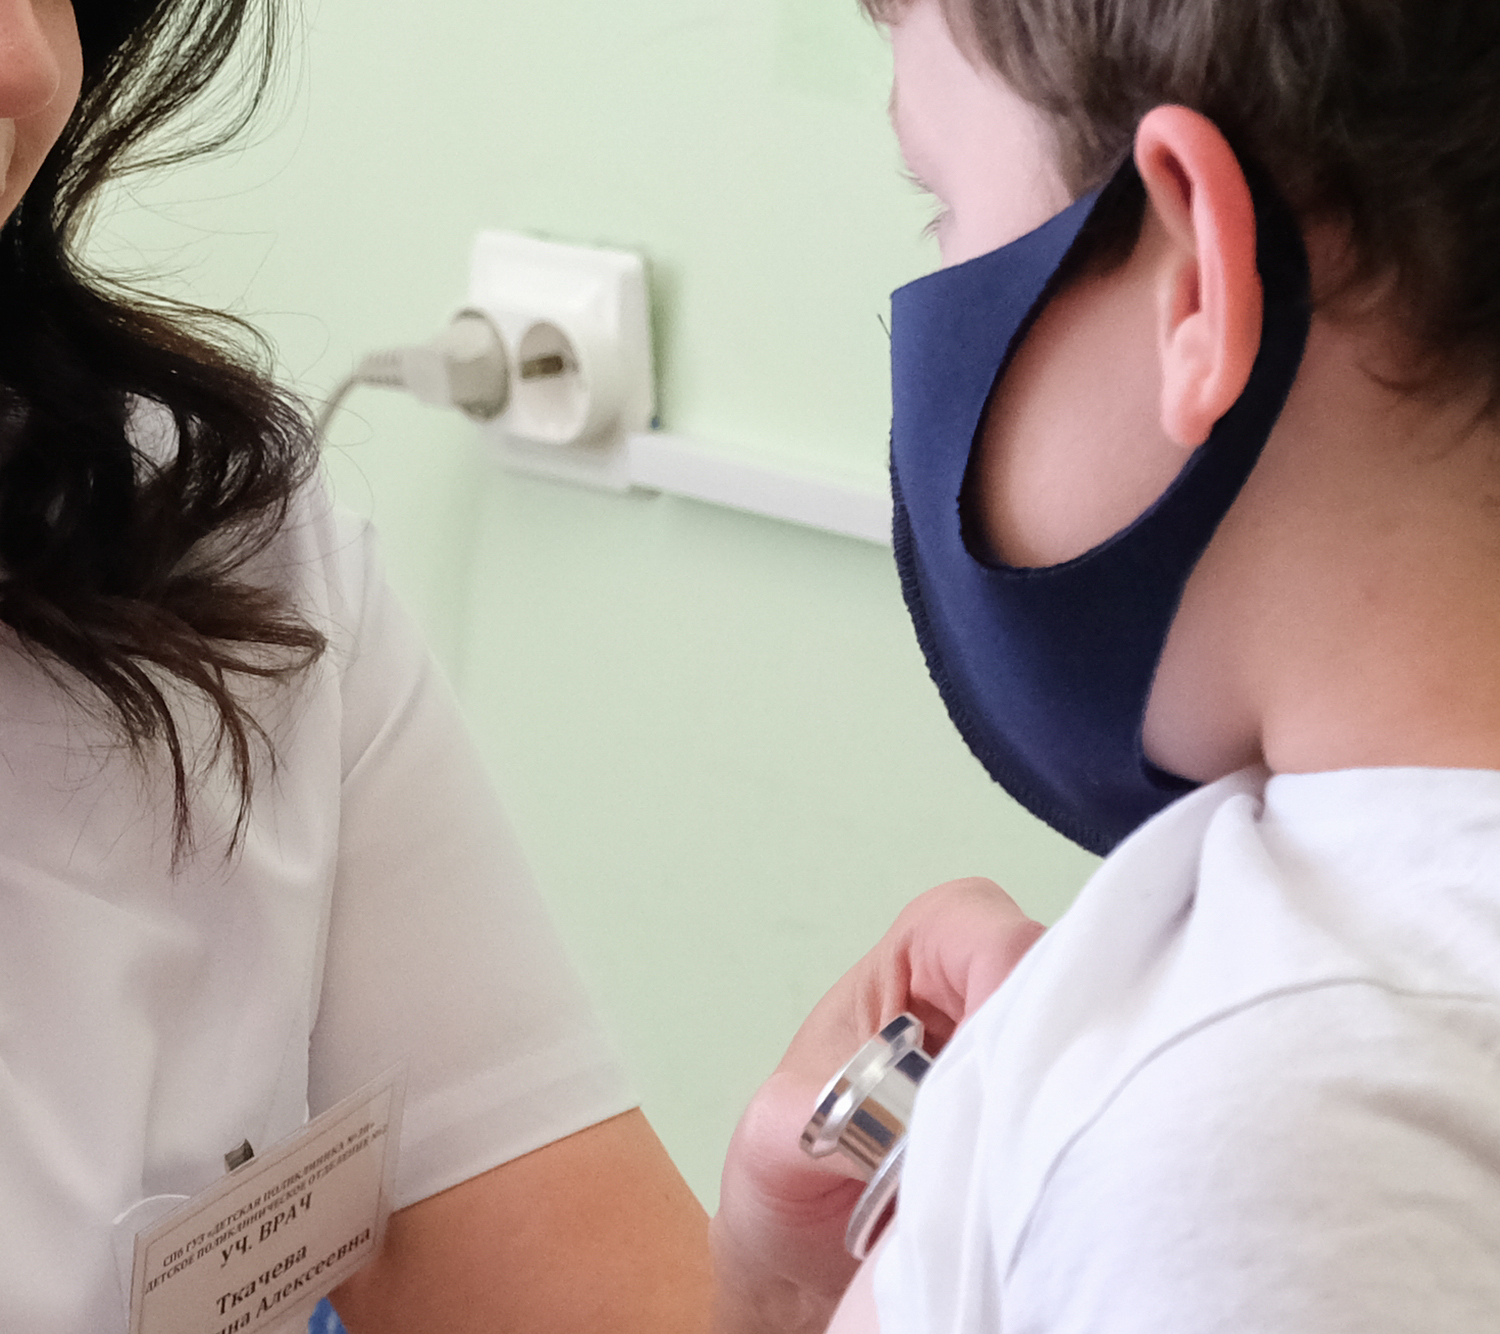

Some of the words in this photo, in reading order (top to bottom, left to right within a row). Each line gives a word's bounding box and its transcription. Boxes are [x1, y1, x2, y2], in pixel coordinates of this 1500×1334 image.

[220, 1234, 253, 1268] УЧ.
[259, 1191, 312, 1244] ВРАЧ
[145, 1253, 196, 1295] ДЕТСКОЕ
[216, 1245, 307, 1316] Ткачева
[255, 1227, 370, 1319] Алексеевна
